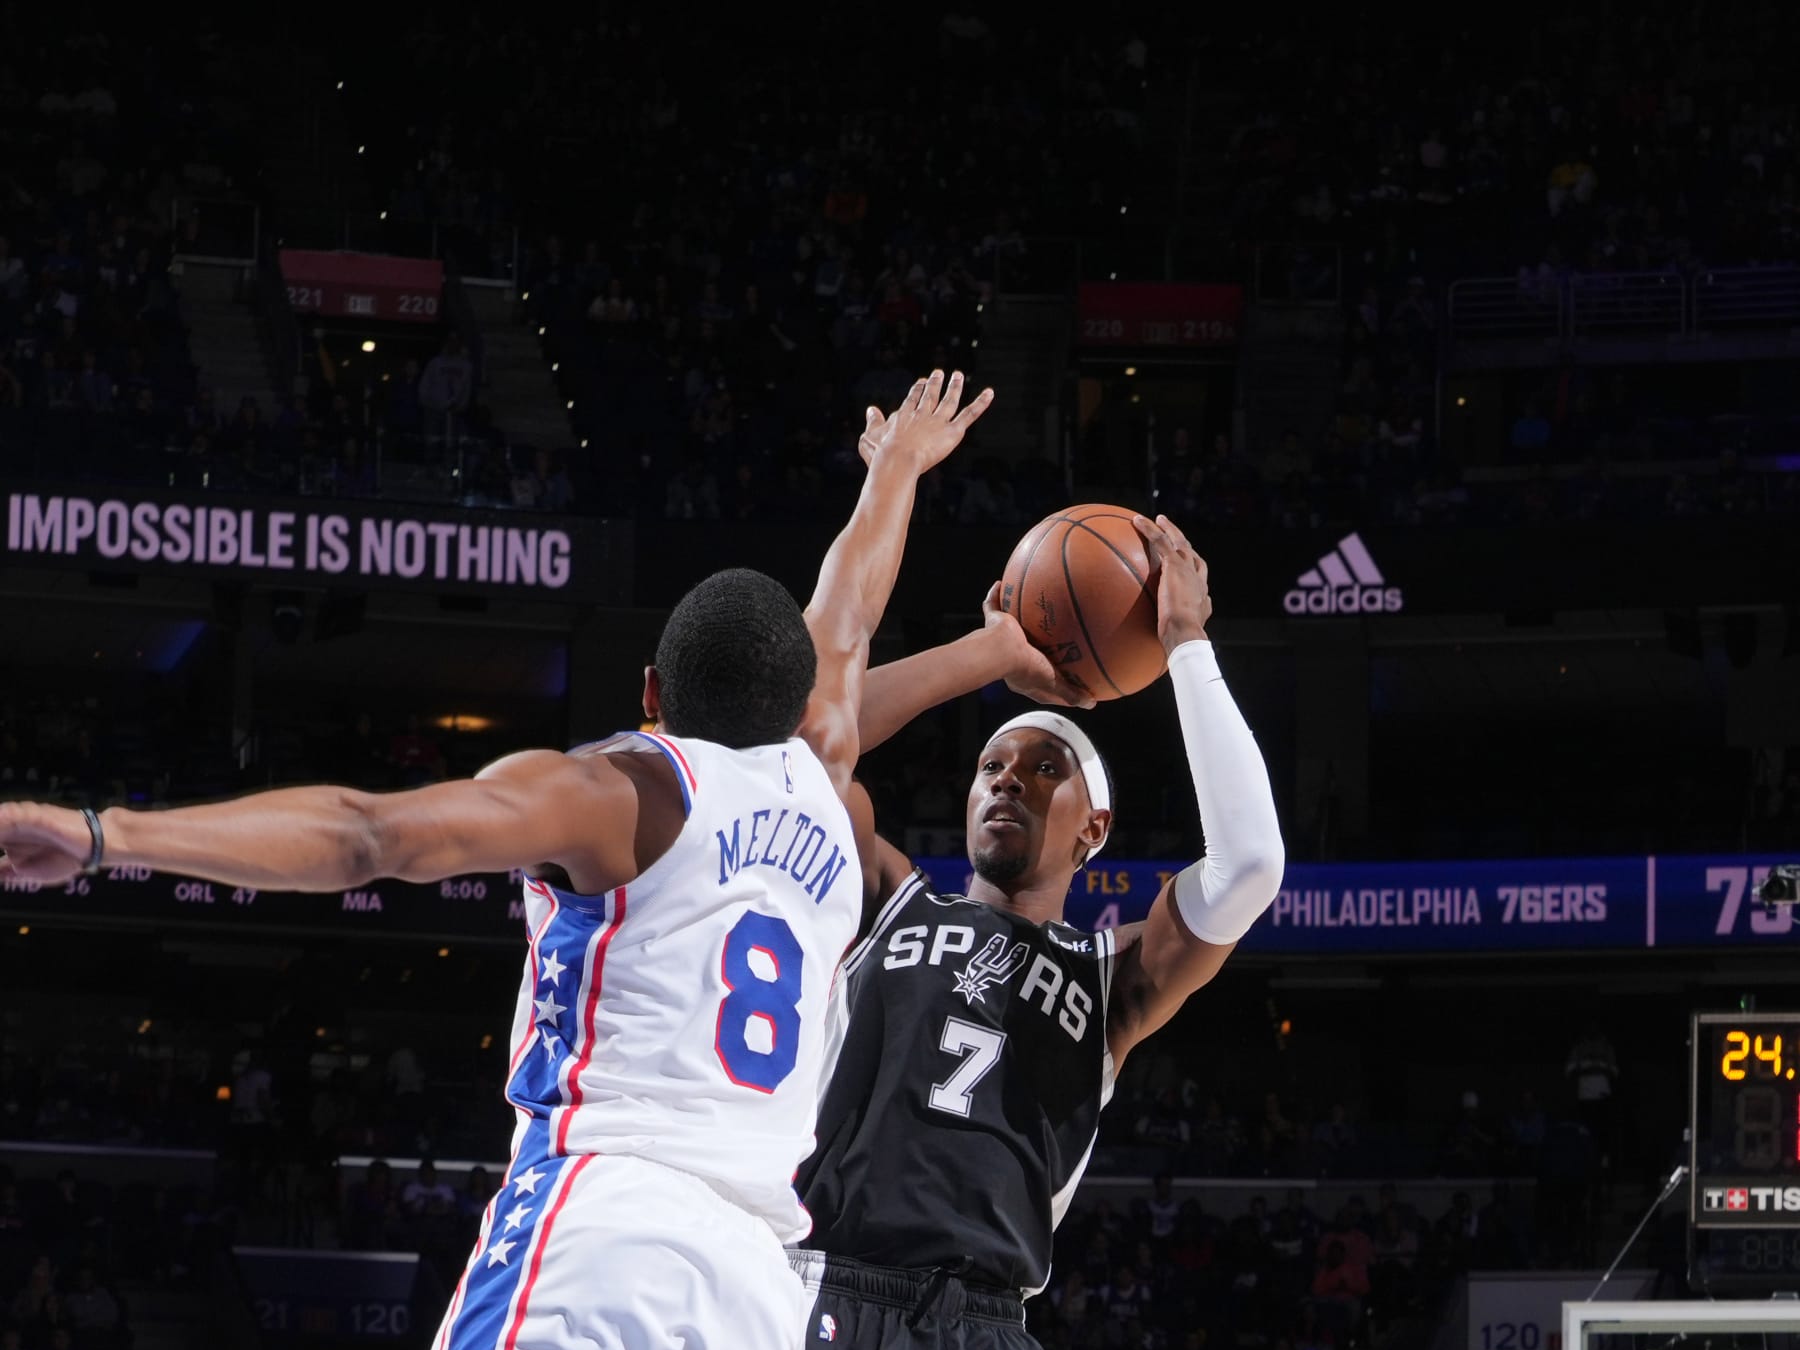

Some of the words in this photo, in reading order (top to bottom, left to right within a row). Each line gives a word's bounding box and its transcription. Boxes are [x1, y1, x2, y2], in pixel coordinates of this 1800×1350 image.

[398, 294, 438, 315] 220
[8, 494, 296, 569] IMPOSSIBLE
[306, 514, 350, 574] IS
[360, 518, 571, 588] NOTHING
[1283, 582, 1403, 614] adidas
[716, 808, 847, 905] MELTON
[174, 882, 216, 904] ORL
[439, 880, 487, 900] 8:00
[1087, 870, 1131, 895] FLS
[342, 891, 383, 912] MIA
[1273, 887, 1482, 926] PHILADELPHIA
[1497, 884, 1607, 924] 76ERS
[884, 924, 1093, 1043] SPURS
[714, 909, 804, 1095] 8
[928, 1016, 1008, 1118] 7
[352, 1303, 409, 1334] 120
[1481, 1322, 1539, 1350] 120
